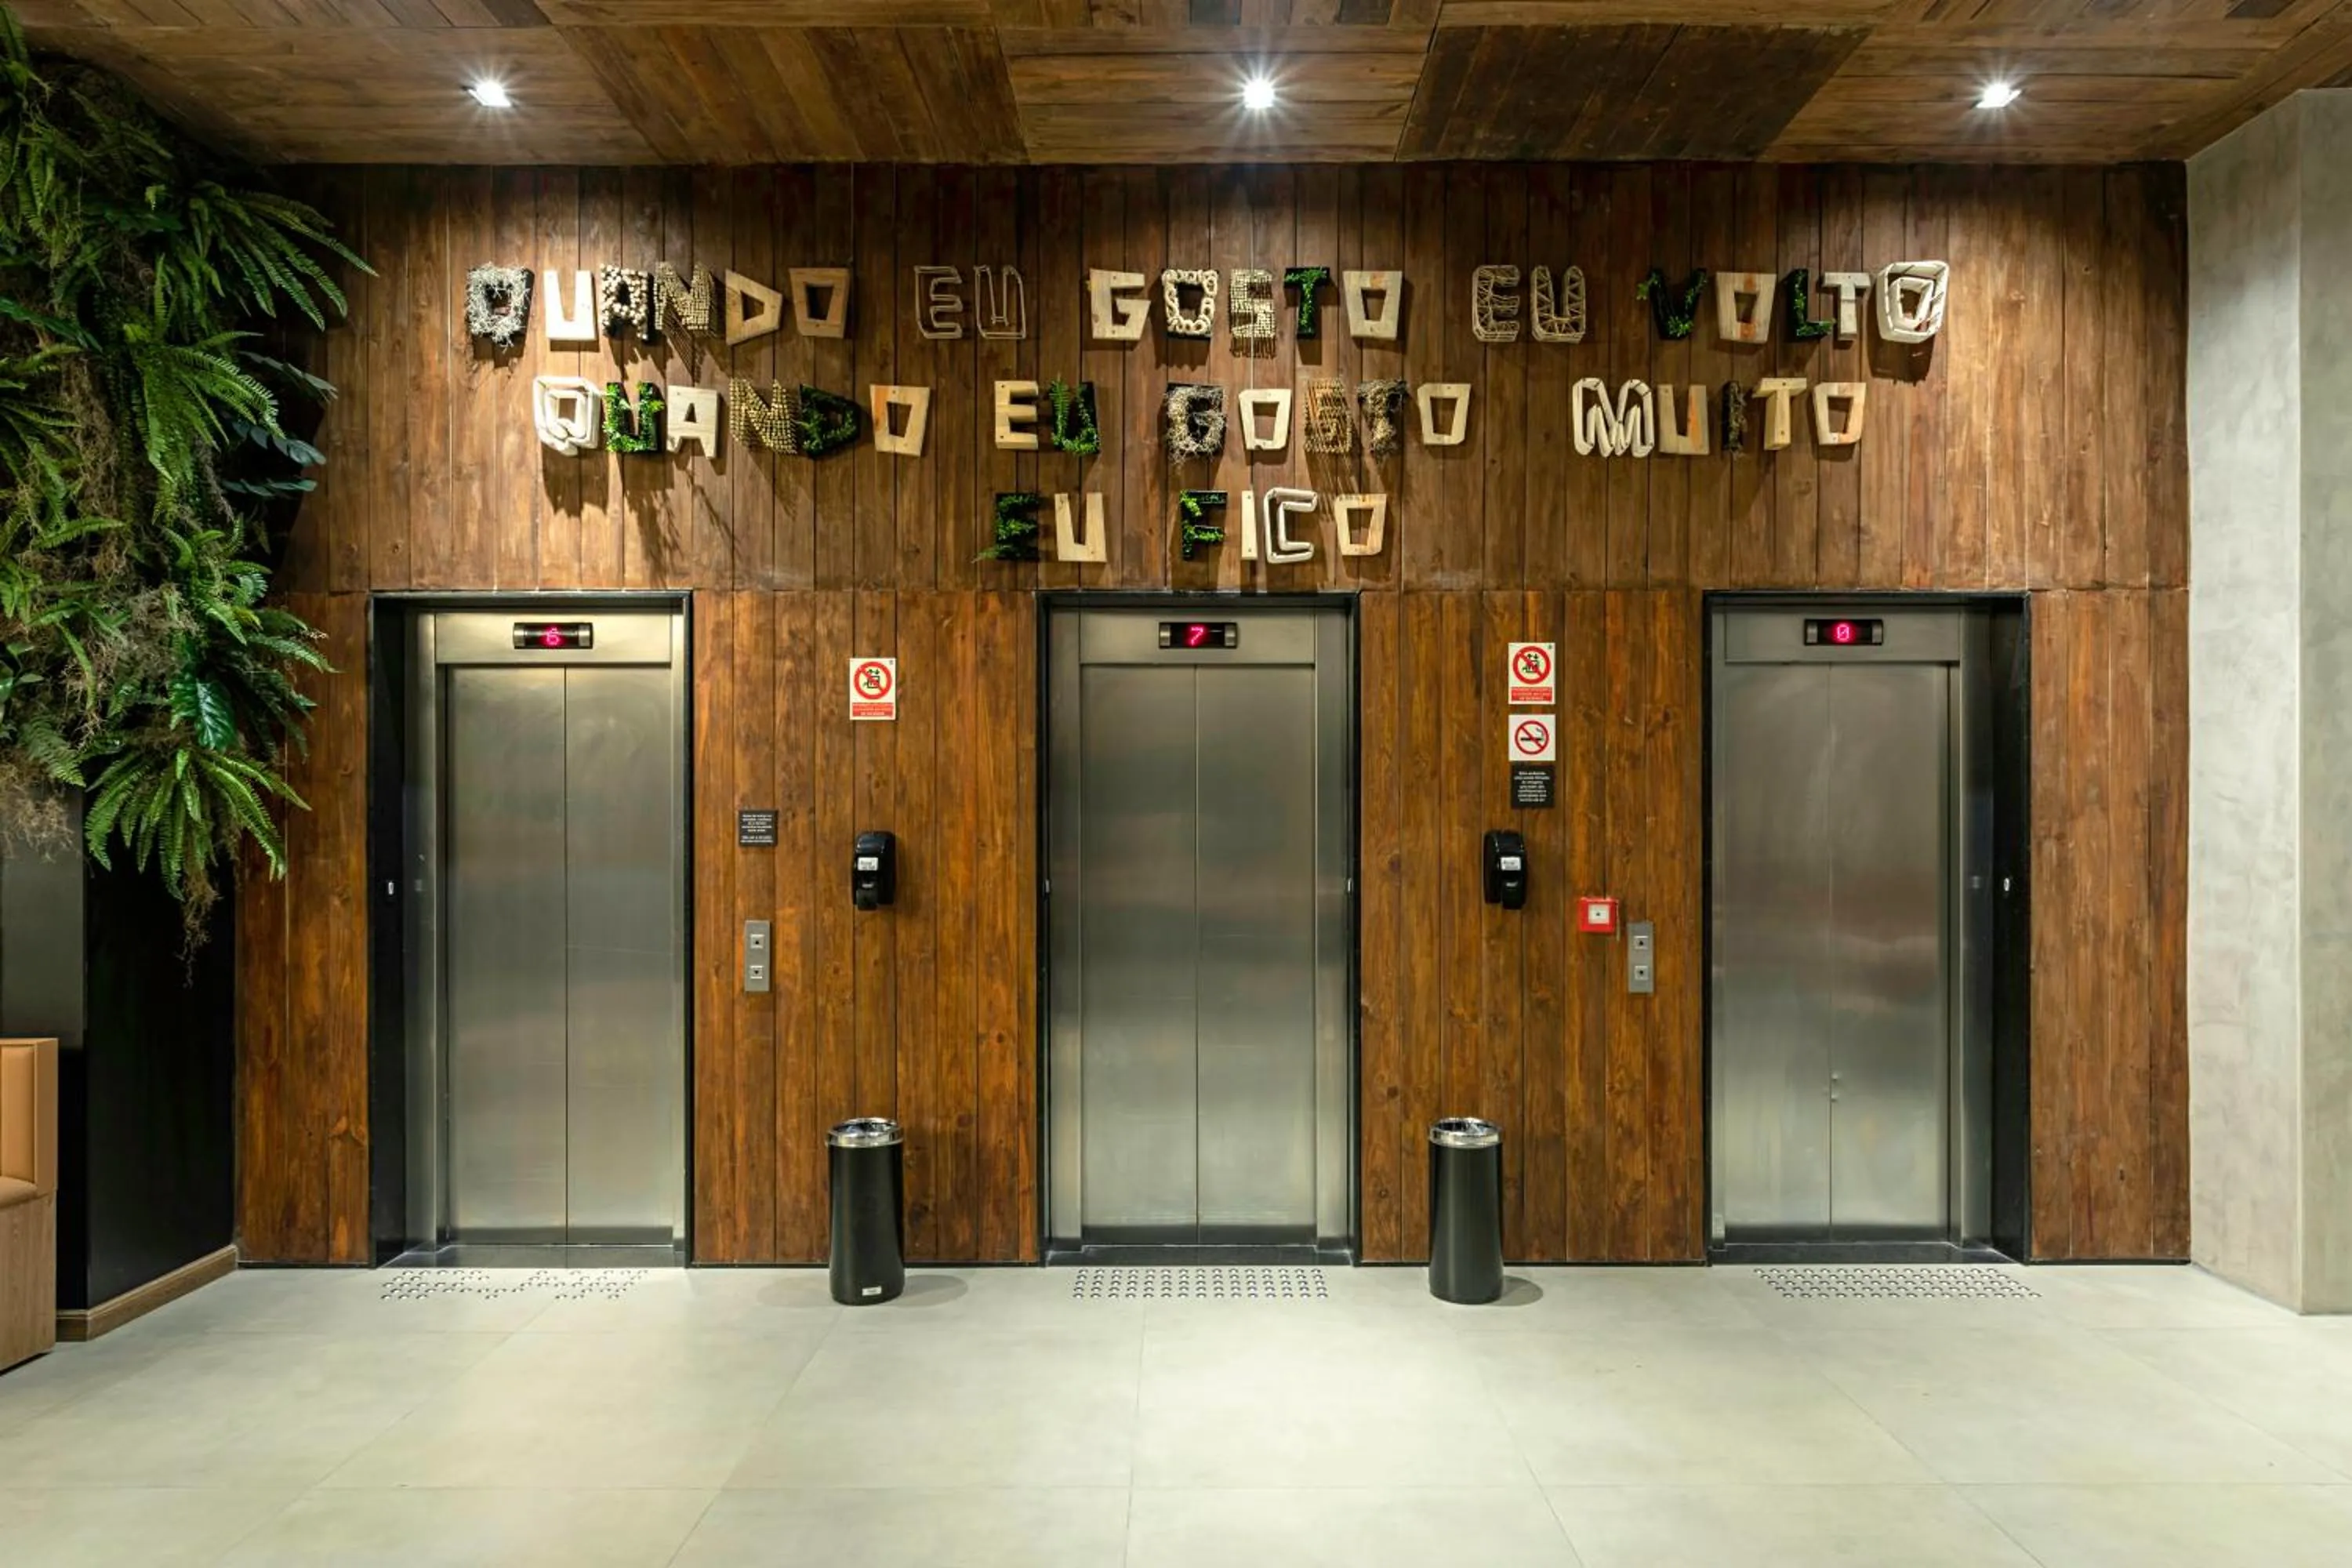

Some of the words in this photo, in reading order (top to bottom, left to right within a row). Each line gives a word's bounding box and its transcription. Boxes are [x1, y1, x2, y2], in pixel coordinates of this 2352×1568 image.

[466, 262, 850, 350] QUANDO
[914, 265, 1025, 339] EU
[1089, 266, 1403, 342] GOSTO
[1472, 265, 1585, 343] EU
[1638, 260, 1949, 343] VOLTO
[533, 376, 931, 459] QUANDO
[995, 376, 1099, 456] EU
[1165, 378, 1472, 461] GOSTO
[1572, 377, 1866, 457] MUITO
[993, 492, 1107, 562] EU
[1181, 487, 1386, 564] FICO
[1191, 626, 1203, 645] 7
[1837, 623, 1849, 642] 0
